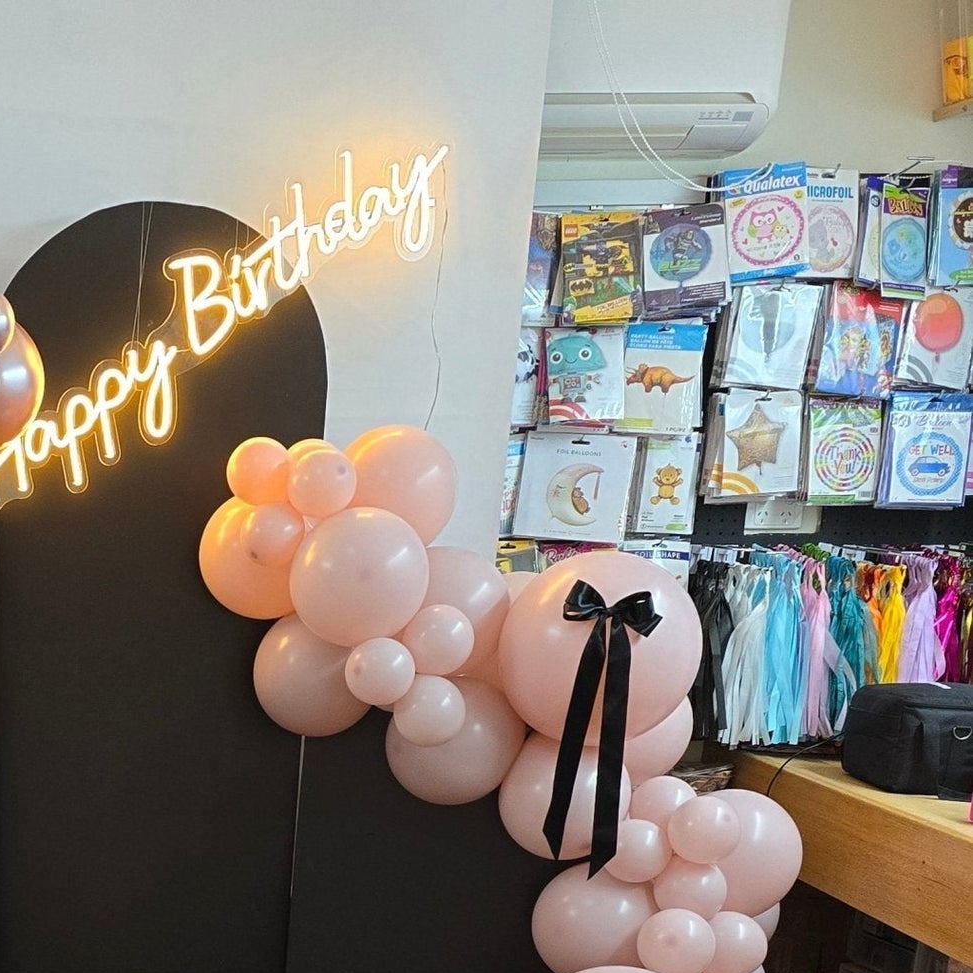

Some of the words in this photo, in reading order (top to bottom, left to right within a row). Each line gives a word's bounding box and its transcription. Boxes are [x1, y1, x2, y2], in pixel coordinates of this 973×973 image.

[743, 175, 801, 194] Qualatex
[168, 145, 449, 357] Birthday
[826, 445, 862, 460] Thank
[909, 444, 928, 455] GET
[930, 444, 955, 456] WELL
[656, 551, 681, 559] SHAPE
